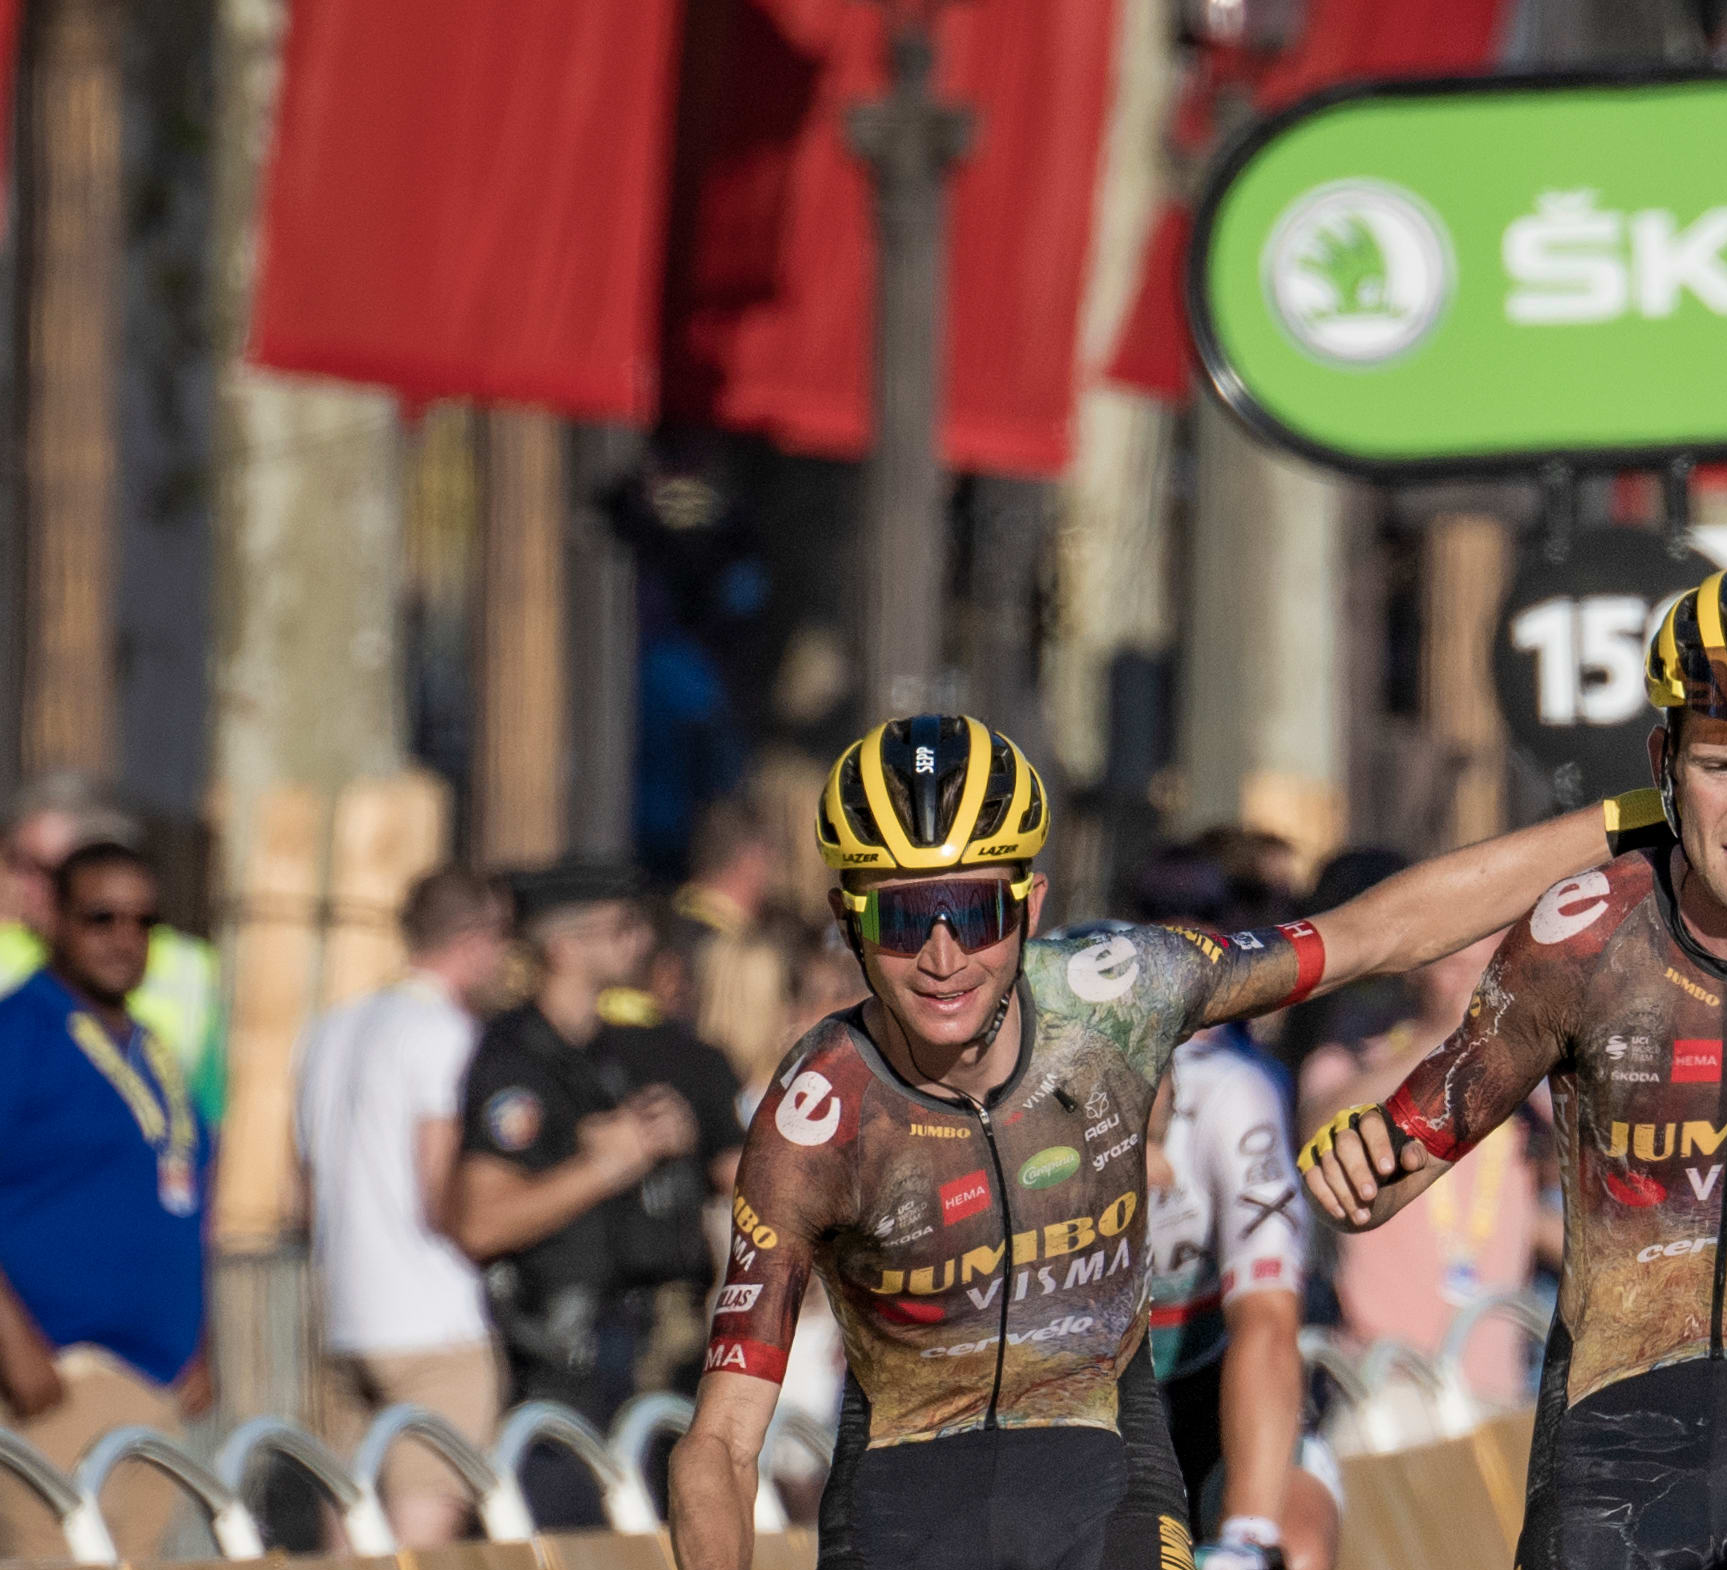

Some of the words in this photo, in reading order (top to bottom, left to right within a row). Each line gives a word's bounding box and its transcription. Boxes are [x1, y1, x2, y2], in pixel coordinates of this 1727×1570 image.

[1512, 597, 1650, 727] 15
[915, 746, 935, 774] SEPP
[842, 852, 879, 864] LAZER
[977, 844, 1020, 856] LAZER
[1663, 967, 1720, 1007] JUMBO
[1675, 1055, 1718, 1067] HEMA
[1022, 1072, 1059, 1110] VISMA
[909, 1123, 972, 1139] JUMBO
[1084, 1113, 1120, 1142] AGU
[1092, 1132, 1140, 1172] graze
[945, 1185, 986, 1210] HEMA
[870, 1191, 1137, 1295] JUMBO
[966, 1236, 1130, 1311] VISMA
[919, 1315, 1094, 1359] cervélo
